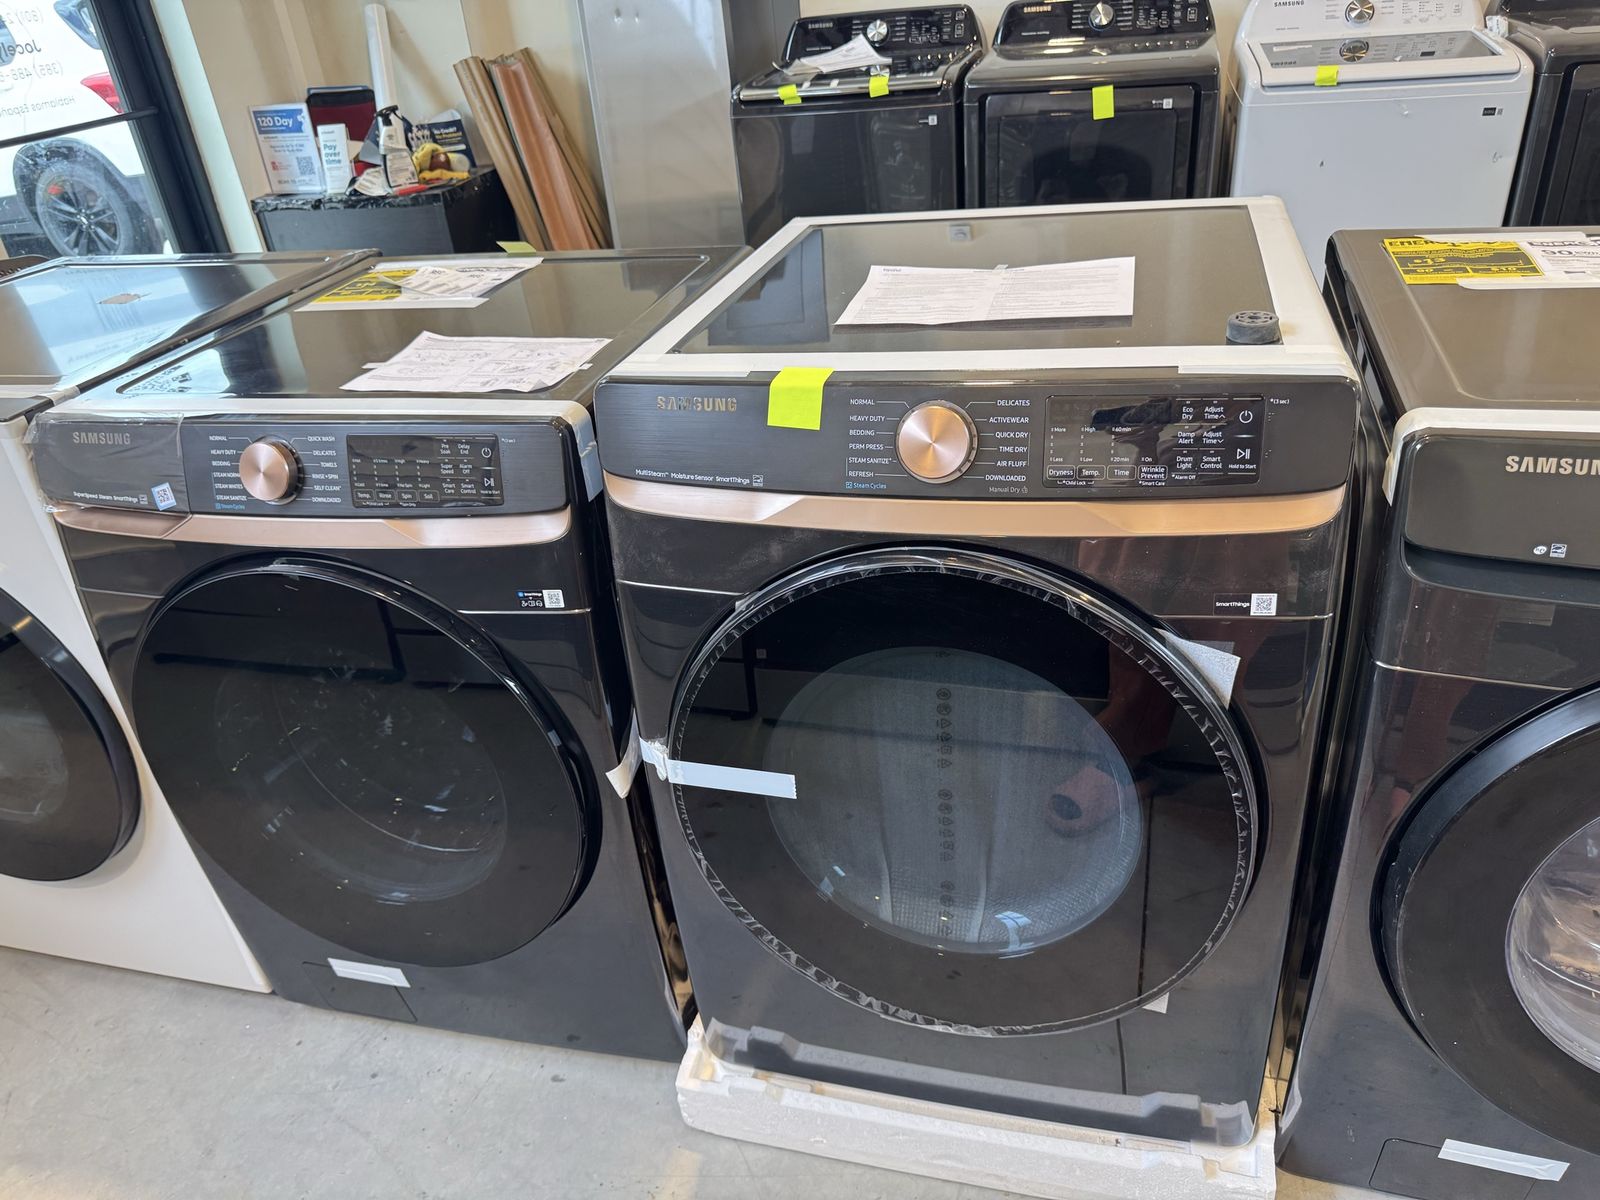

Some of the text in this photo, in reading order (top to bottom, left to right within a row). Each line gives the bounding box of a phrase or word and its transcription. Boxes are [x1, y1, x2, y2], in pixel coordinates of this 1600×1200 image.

[257, 116, 293, 128] 120 Day
[323, 144, 337, 152] Pay
[657, 396, 737, 412] SAMSUNG
[1204, 406, 1224, 414] Adjust
[72, 431, 132, 445] SAMSUNG
[1049, 469, 1074, 477] Dryness
[1081, 469, 1101, 477] Temp.
[715, 475, 750, 485] SmartThings
